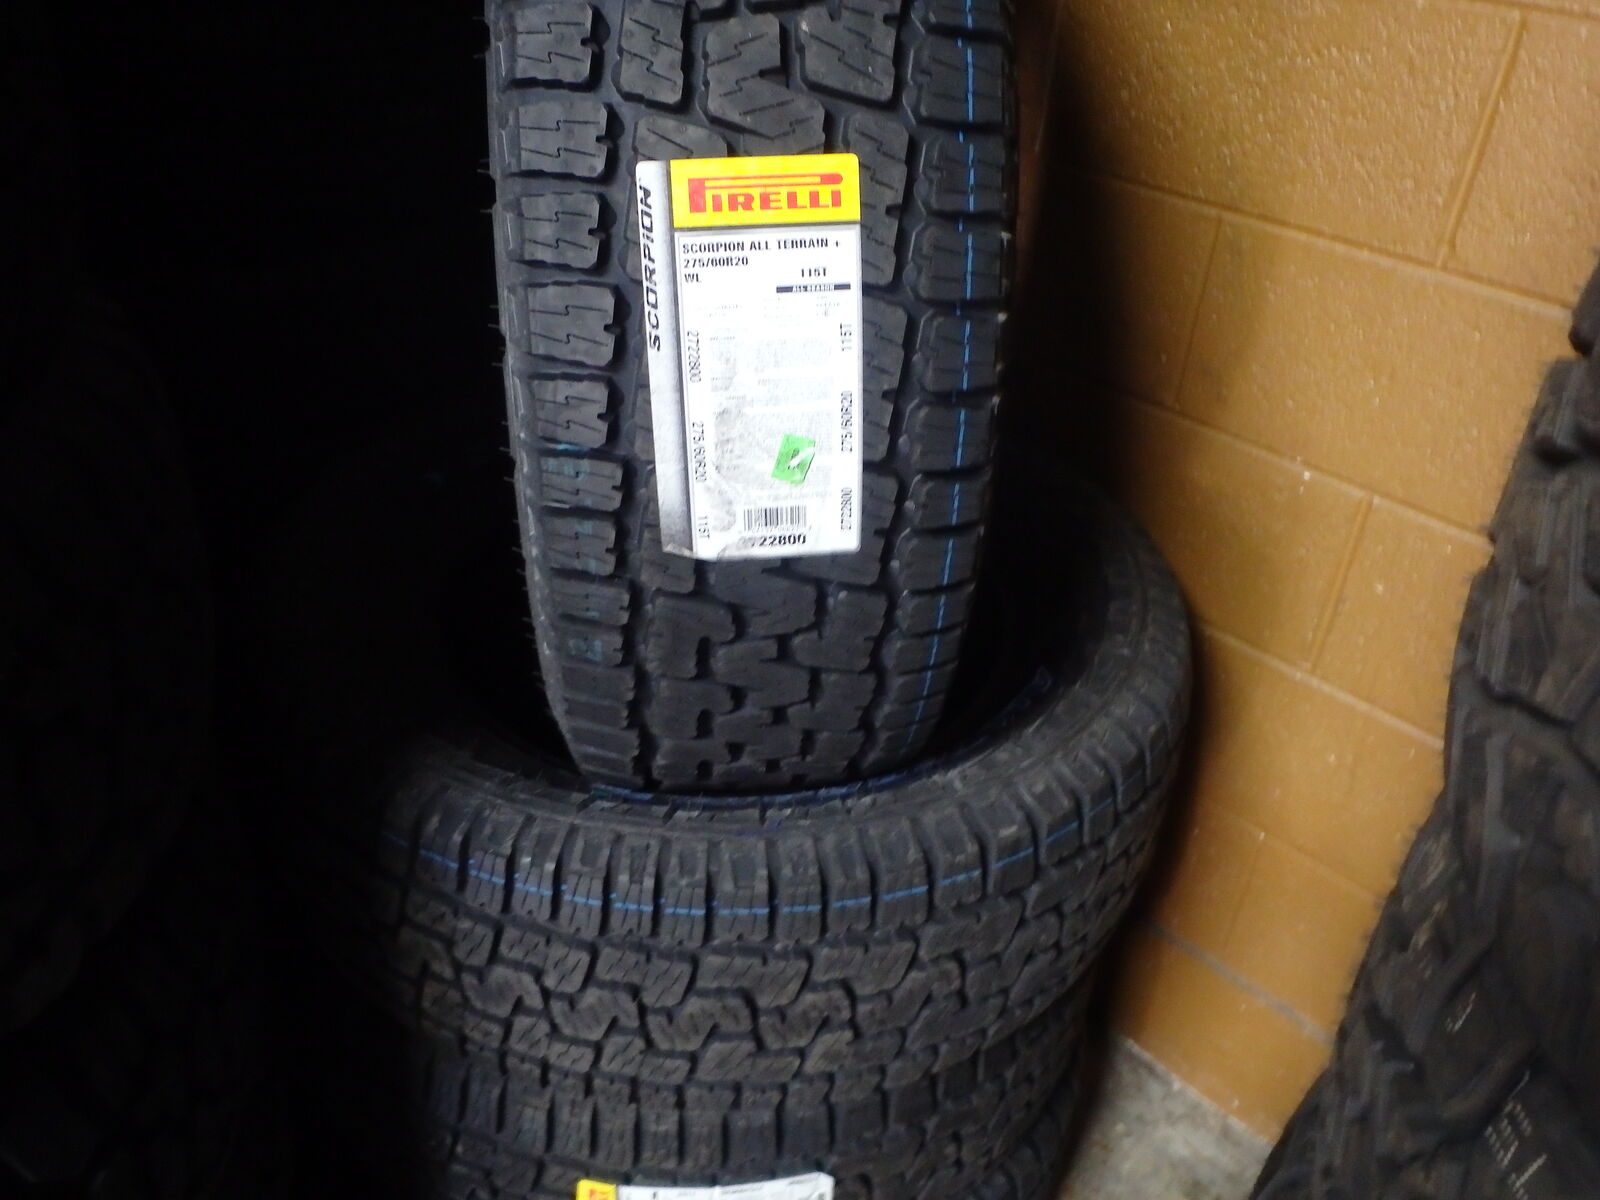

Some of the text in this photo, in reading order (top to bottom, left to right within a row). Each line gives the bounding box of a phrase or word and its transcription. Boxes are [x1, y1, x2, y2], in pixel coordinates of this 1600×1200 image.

[687, 172, 844, 214] PIRELLI
[682, 240, 745, 255] SCORPION
[749, 239, 771, 252] ALL
[776, 237, 829, 251] TERRAIN
[638, 186, 662, 352] SCORPION
[683, 272, 702, 284] WL
[800, 266, 828, 278] 115T
[839, 322, 853, 352] 115T
[686, 329, 702, 384] 2722800
